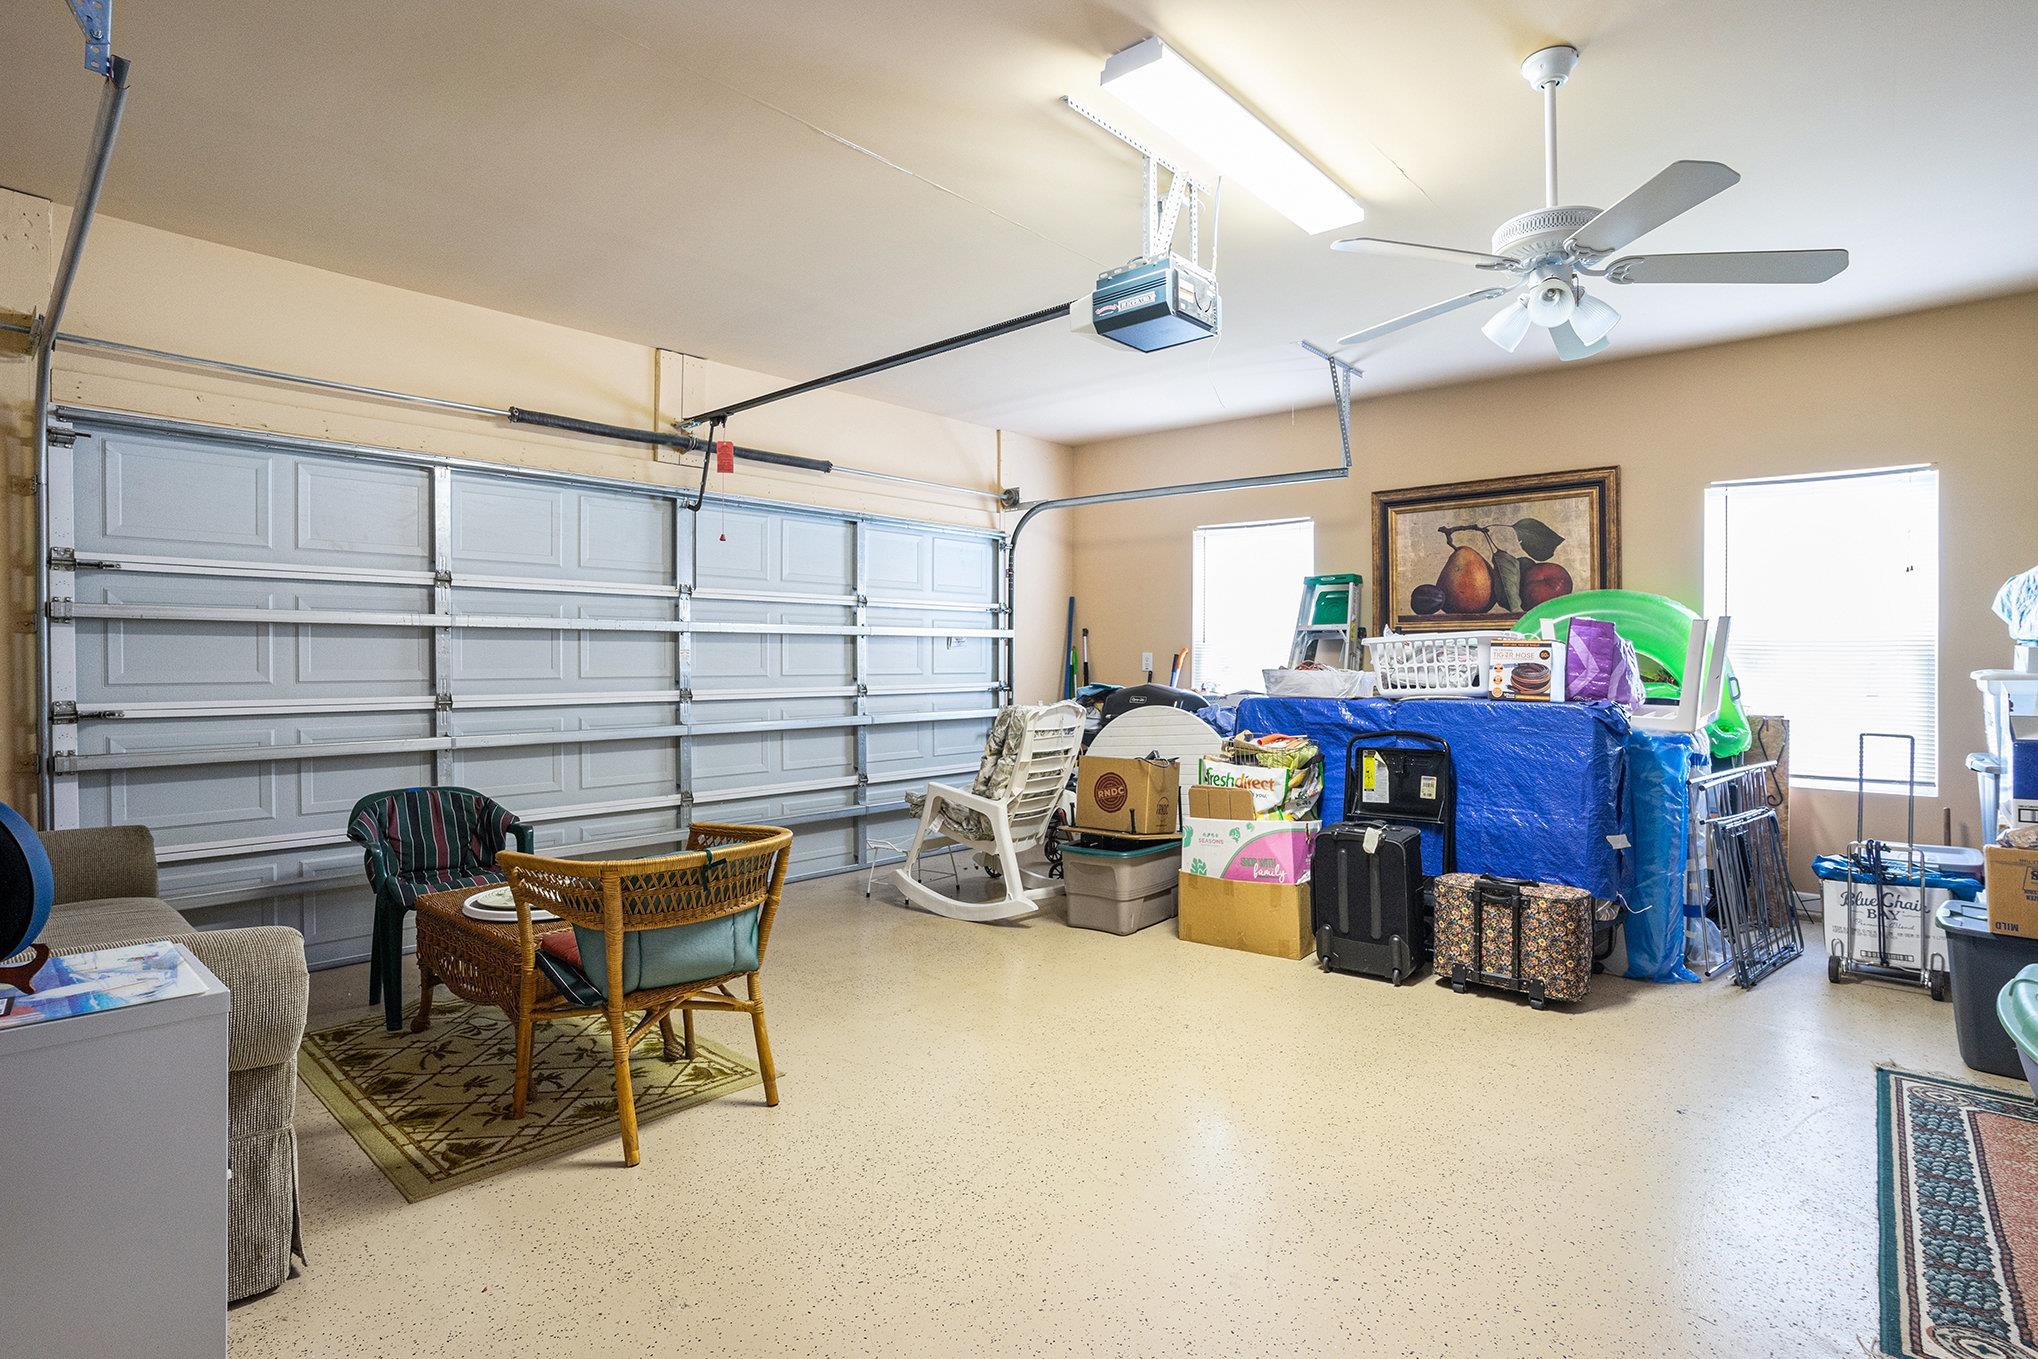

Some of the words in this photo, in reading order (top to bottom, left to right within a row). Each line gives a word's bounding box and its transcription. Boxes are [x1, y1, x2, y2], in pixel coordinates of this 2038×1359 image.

[1098, 786, 1125, 798] RNDC
[1253, 863, 1287, 883] family
[1840, 891, 1879, 907] Blue
[1995, 921, 2019, 932] MILD
